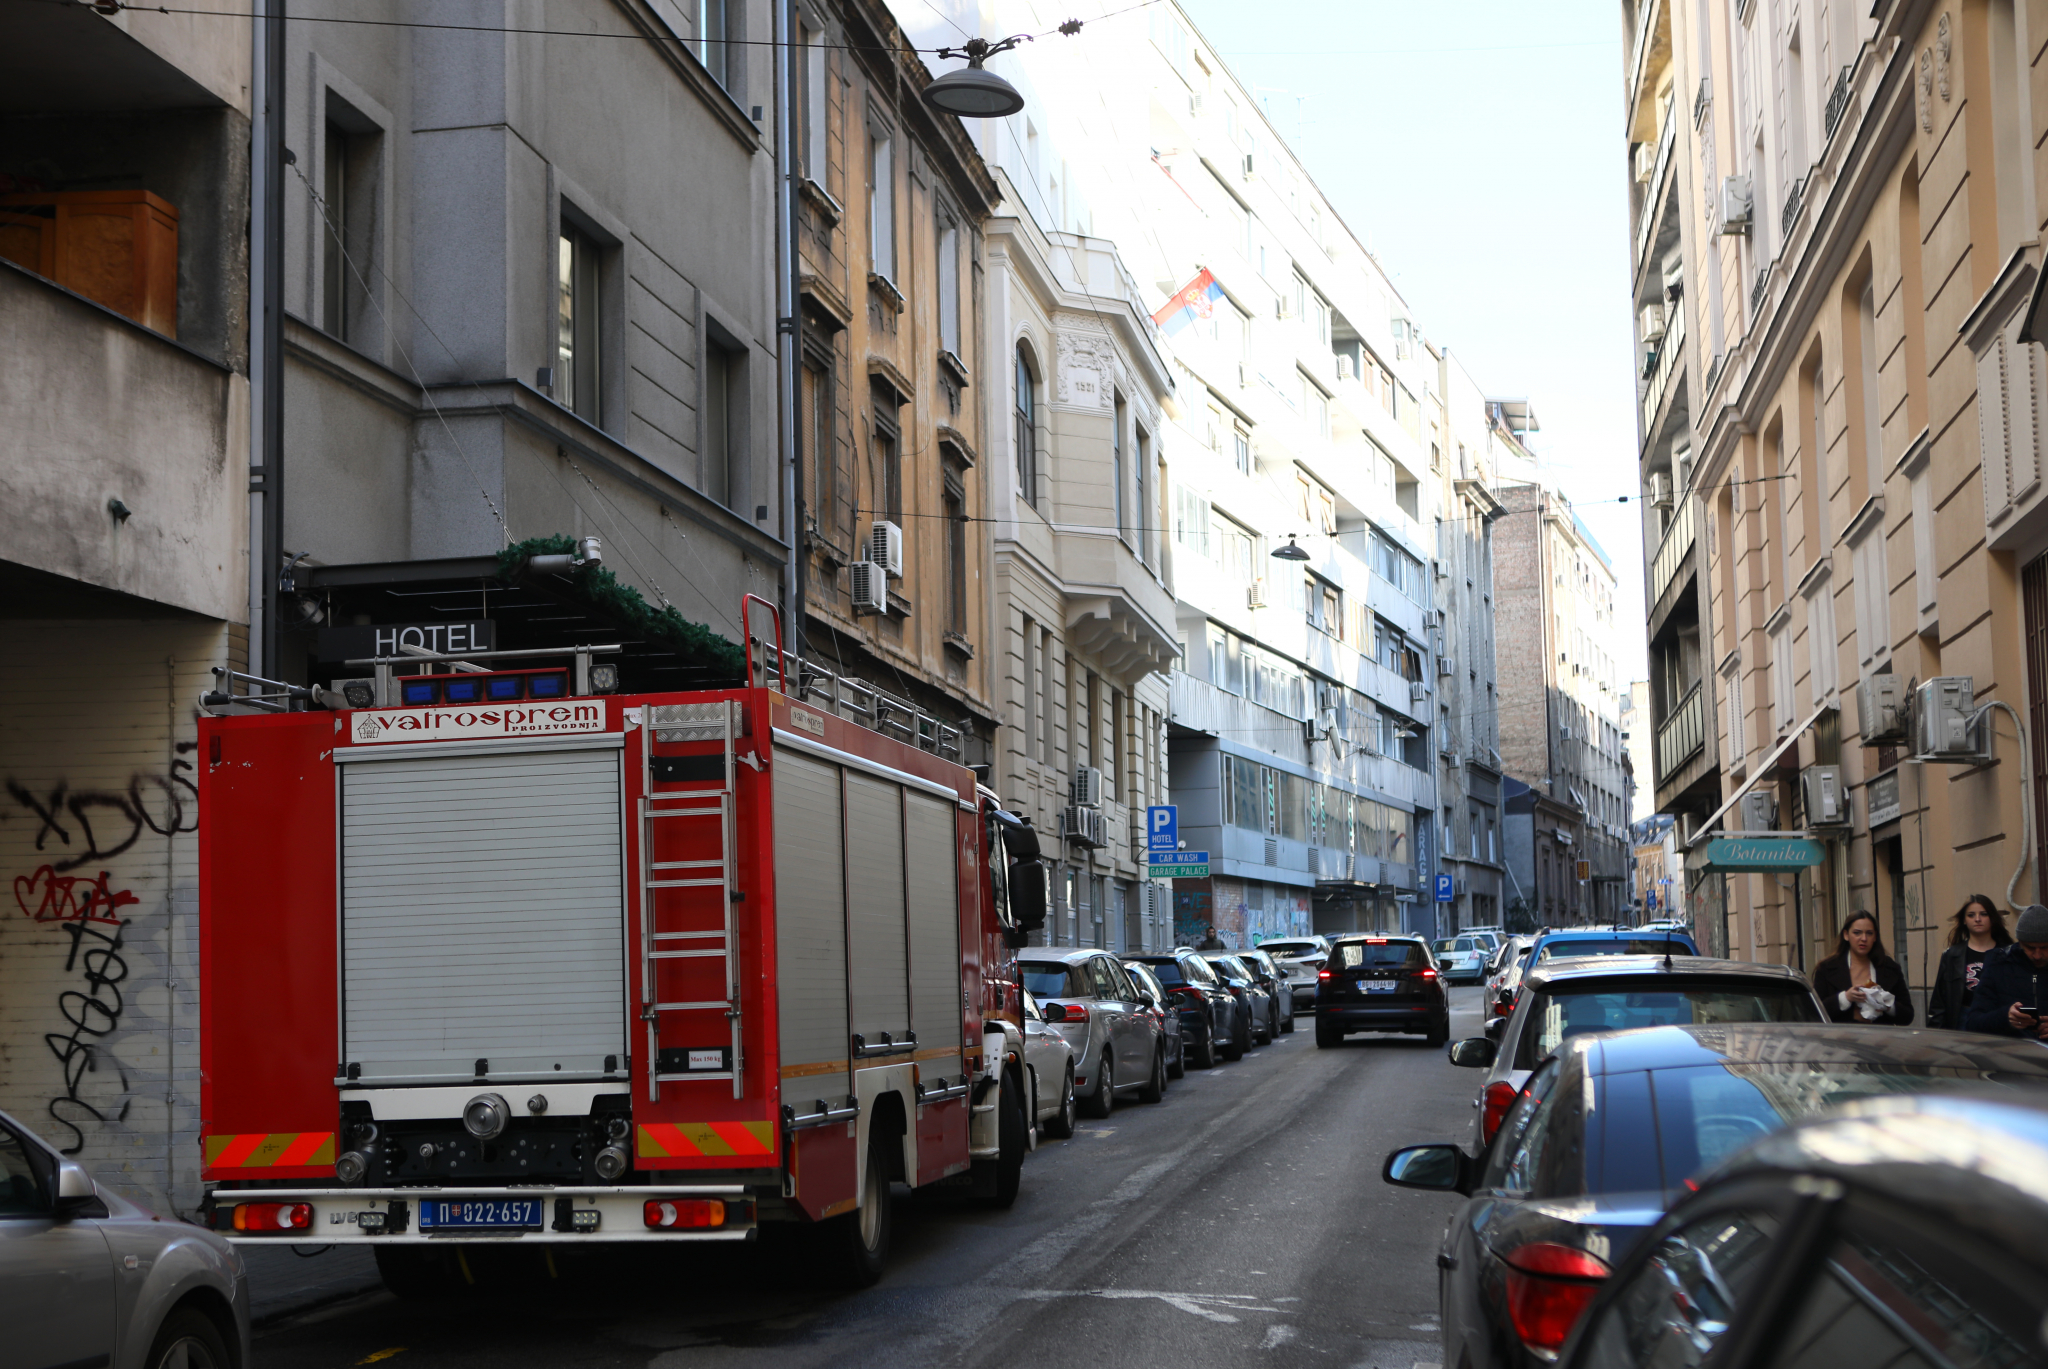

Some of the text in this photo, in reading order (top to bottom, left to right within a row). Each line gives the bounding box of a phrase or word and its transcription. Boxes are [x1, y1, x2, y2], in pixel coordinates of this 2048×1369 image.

[375, 623, 488, 656] HOTEL
[377, 705, 599, 732] vatrosprem
[512, 721, 599, 732] PROIZVODNJA
[1154, 809, 1171, 833] P
[1152, 835, 1173, 843] HOTEL
[1159, 853, 1198, 863] CAR WASH
[1724, 842, 1808, 861] Botanika
[1150, 866, 1207, 876] GARAGE PALACE
[1439, 877, 1450, 891] P
[330, 1212, 357, 1224] IVE
